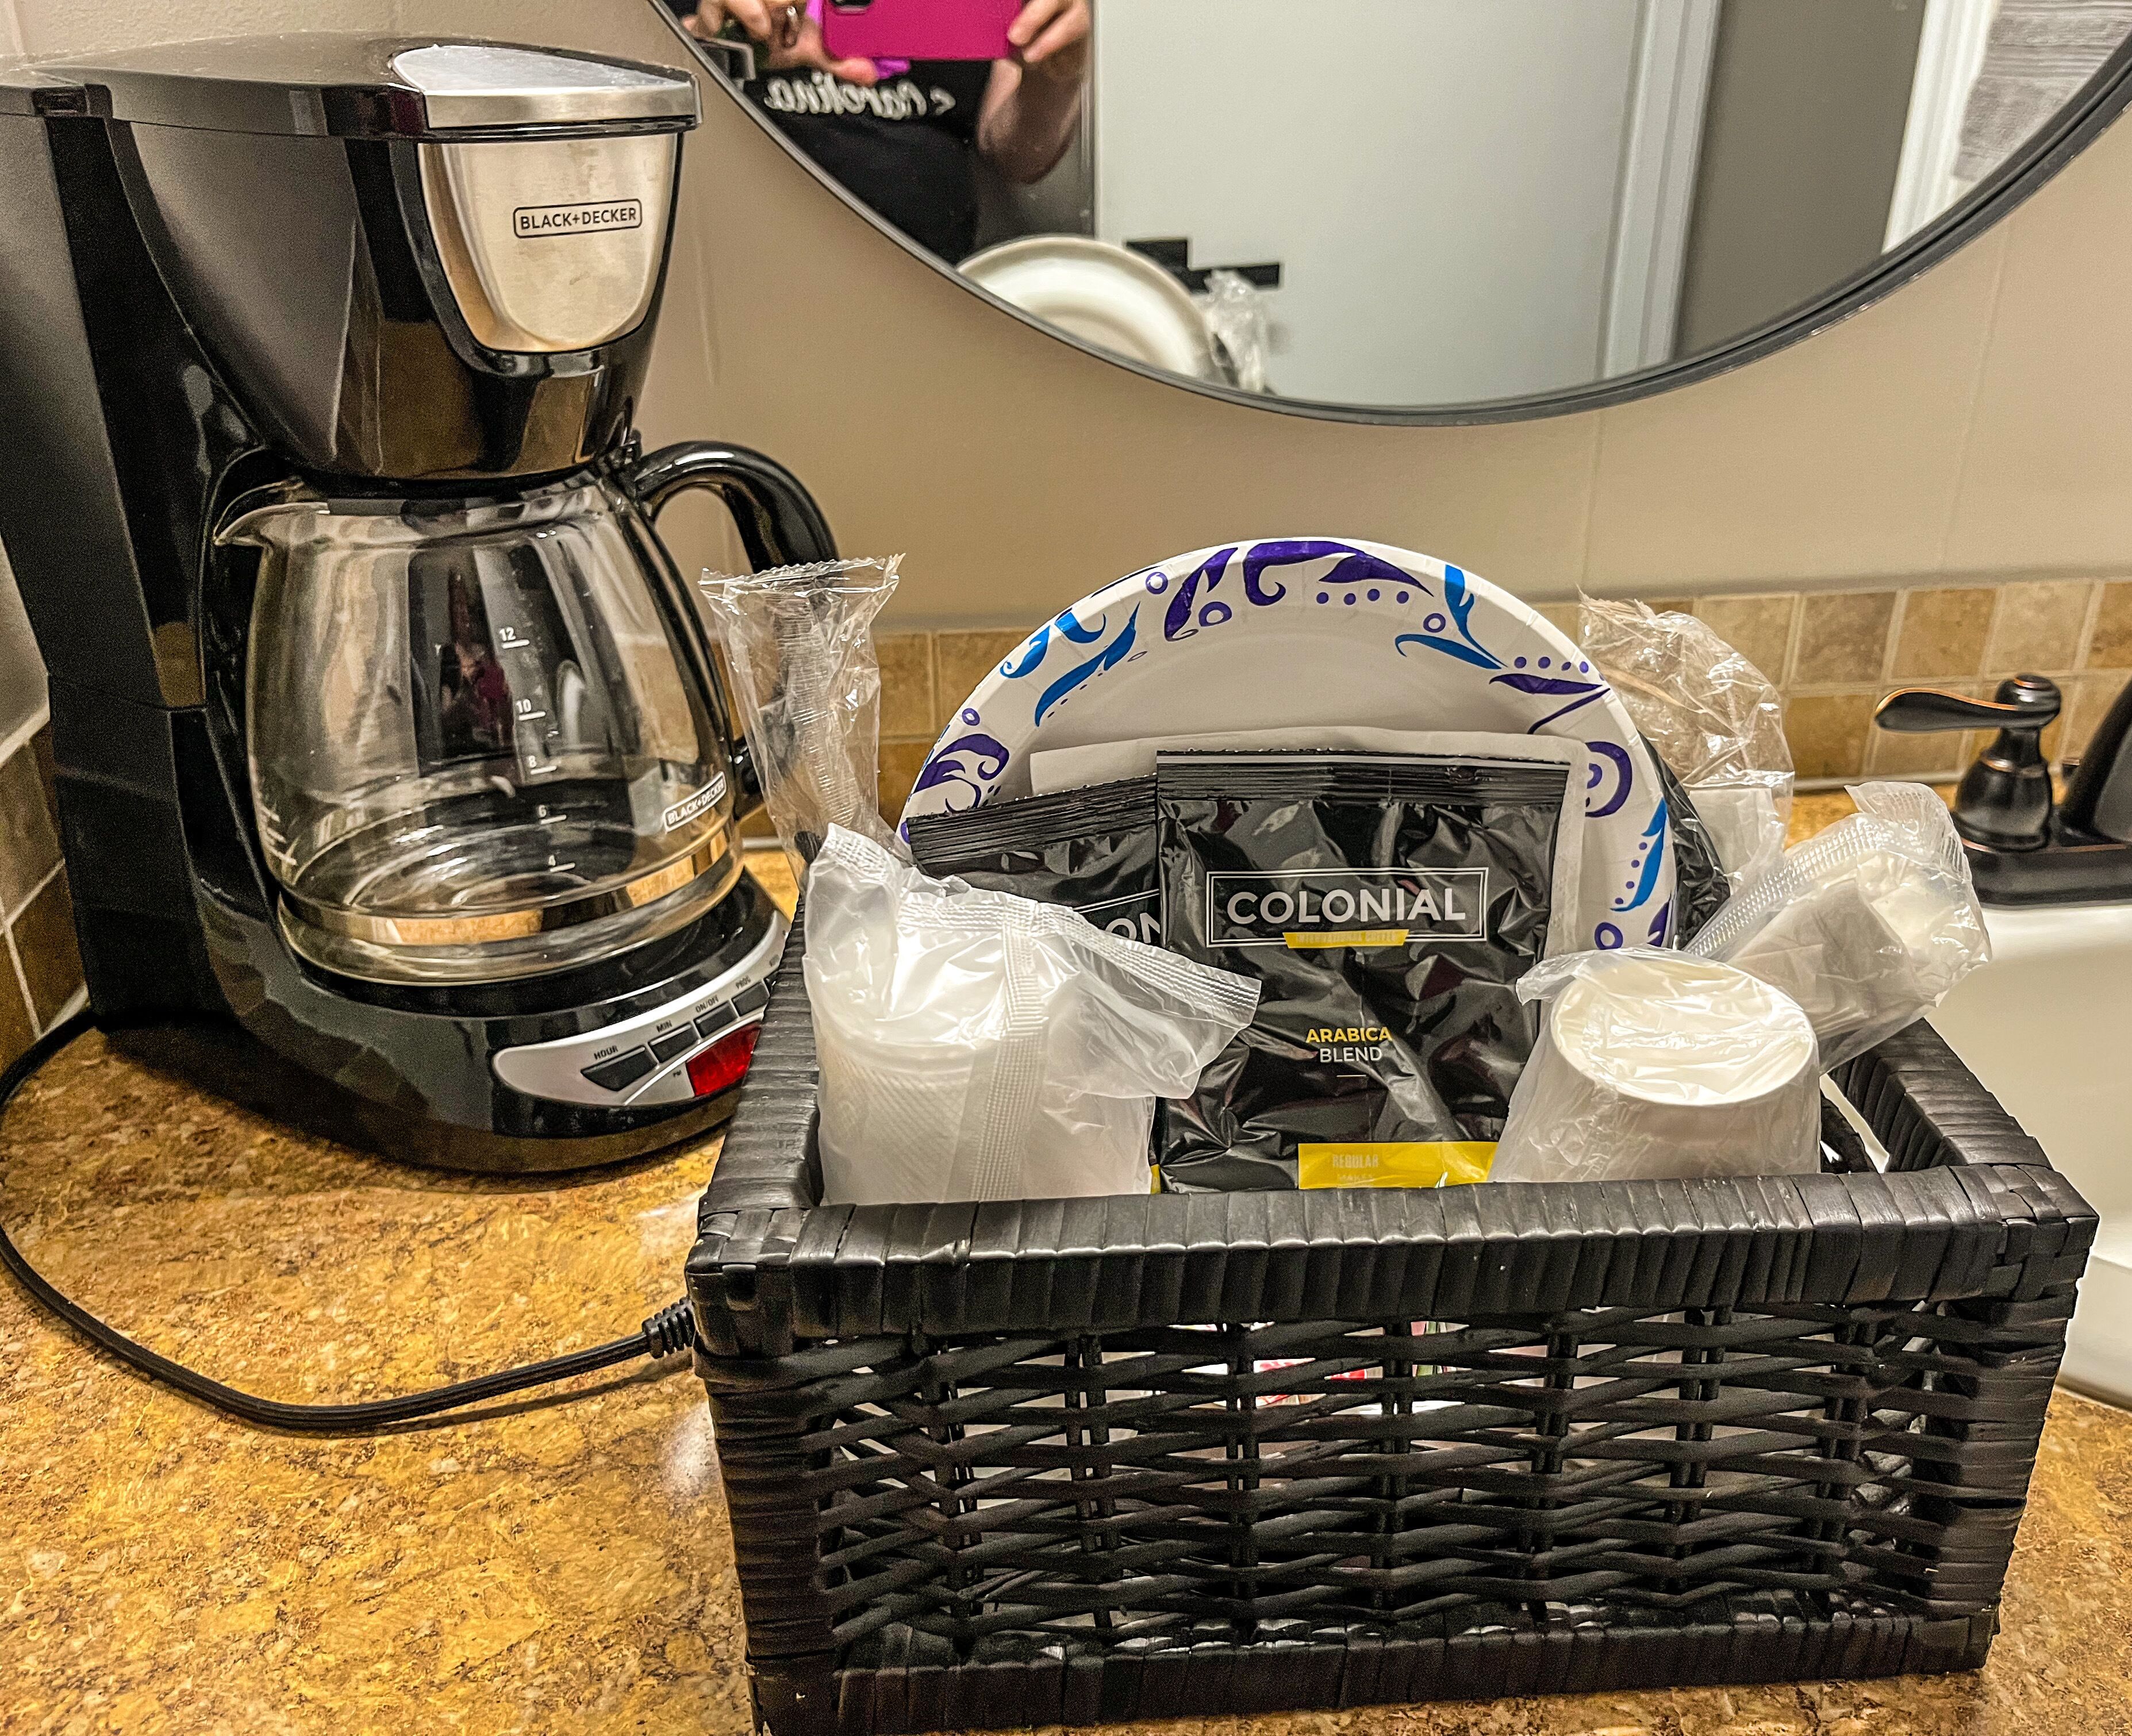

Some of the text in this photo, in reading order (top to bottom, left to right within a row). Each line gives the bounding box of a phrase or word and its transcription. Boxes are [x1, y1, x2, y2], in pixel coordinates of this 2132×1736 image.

[520, 207, 636, 230] BLACK+DECKER
[499, 626, 516, 641] 12
[516, 698, 532, 713] 10
[527, 755, 537, 768] 8
[538, 805, 547, 817] 6
[548, 855, 556, 866] 4
[1227, 888, 1466, 924] COLONIAL
[1305, 1026, 1393, 1043] ARABICA
[594, 1045, 619, 1060] HOUR
[1319, 1046, 1382, 1063] BLEND
